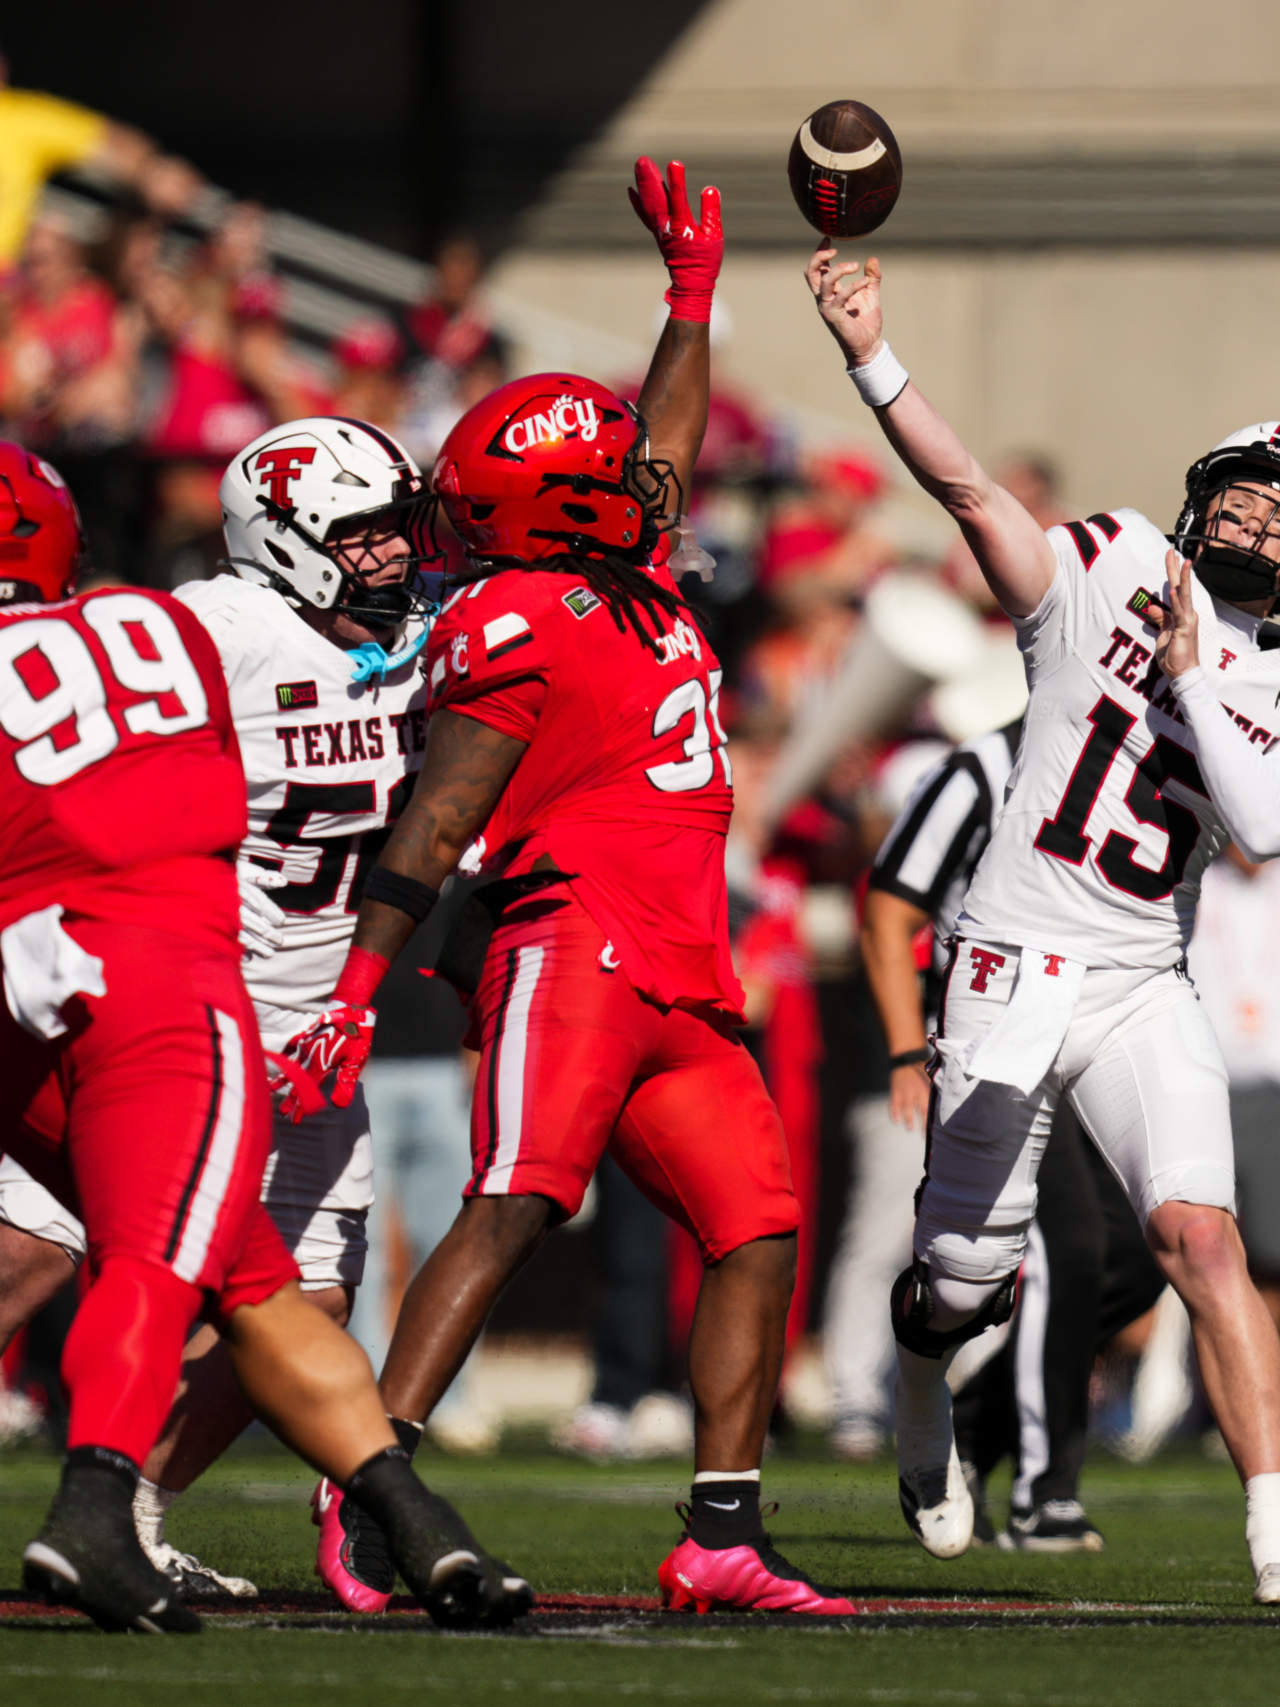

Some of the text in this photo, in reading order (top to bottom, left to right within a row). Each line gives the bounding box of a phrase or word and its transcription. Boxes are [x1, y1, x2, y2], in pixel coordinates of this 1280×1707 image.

[505, 394, 600, 453] CINCY
[0, 593, 210, 788] 99
[1098, 626, 1186, 727] TEXA
[275, 717, 386, 769] TEXAS
[1034, 693, 1213, 901] 15
